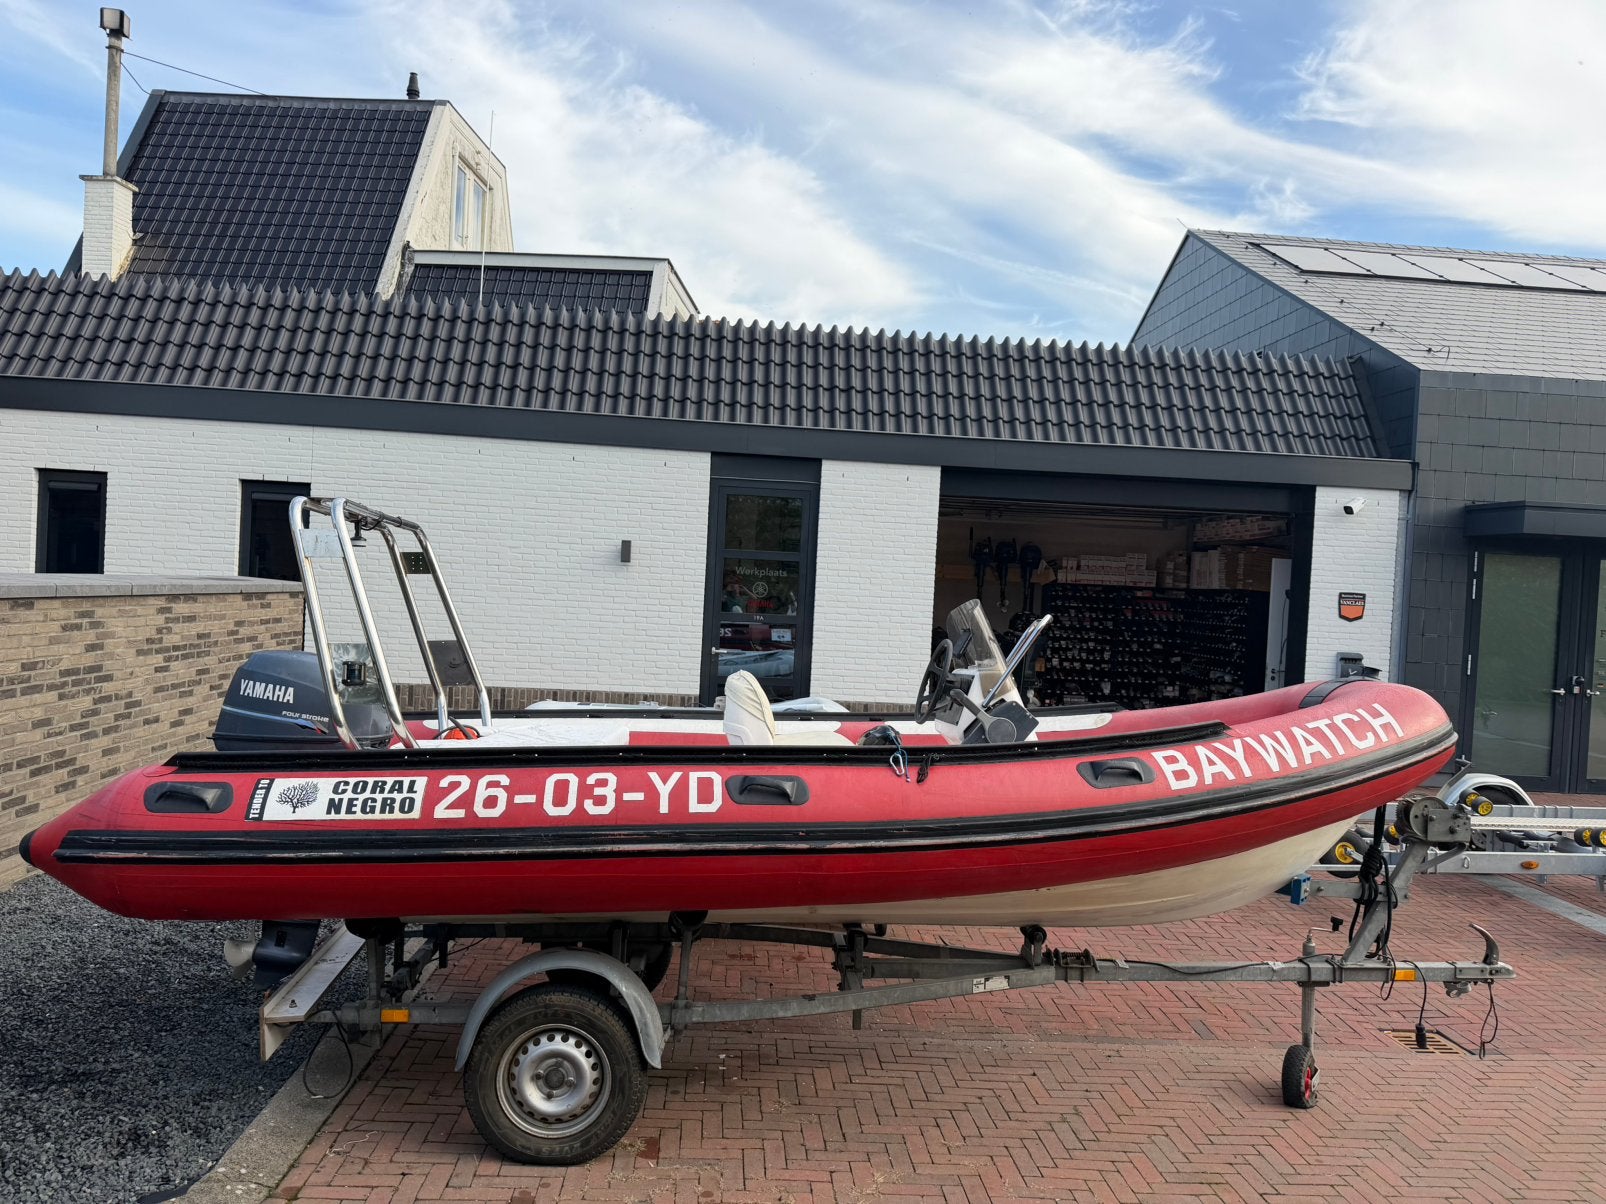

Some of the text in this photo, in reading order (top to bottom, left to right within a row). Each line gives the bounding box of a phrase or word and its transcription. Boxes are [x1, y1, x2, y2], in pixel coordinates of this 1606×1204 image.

[736, 566, 787, 577] Werkplaats
[240, 679, 294, 703] YAMAHA
[1151, 703, 1404, 790] BAYWATCH
[249, 779, 270, 818] TENDER TO
[332, 780, 417, 794] CORAL
[433, 771, 723, 819] 26-03-YD
[326, 797, 415, 815] NEGRO
